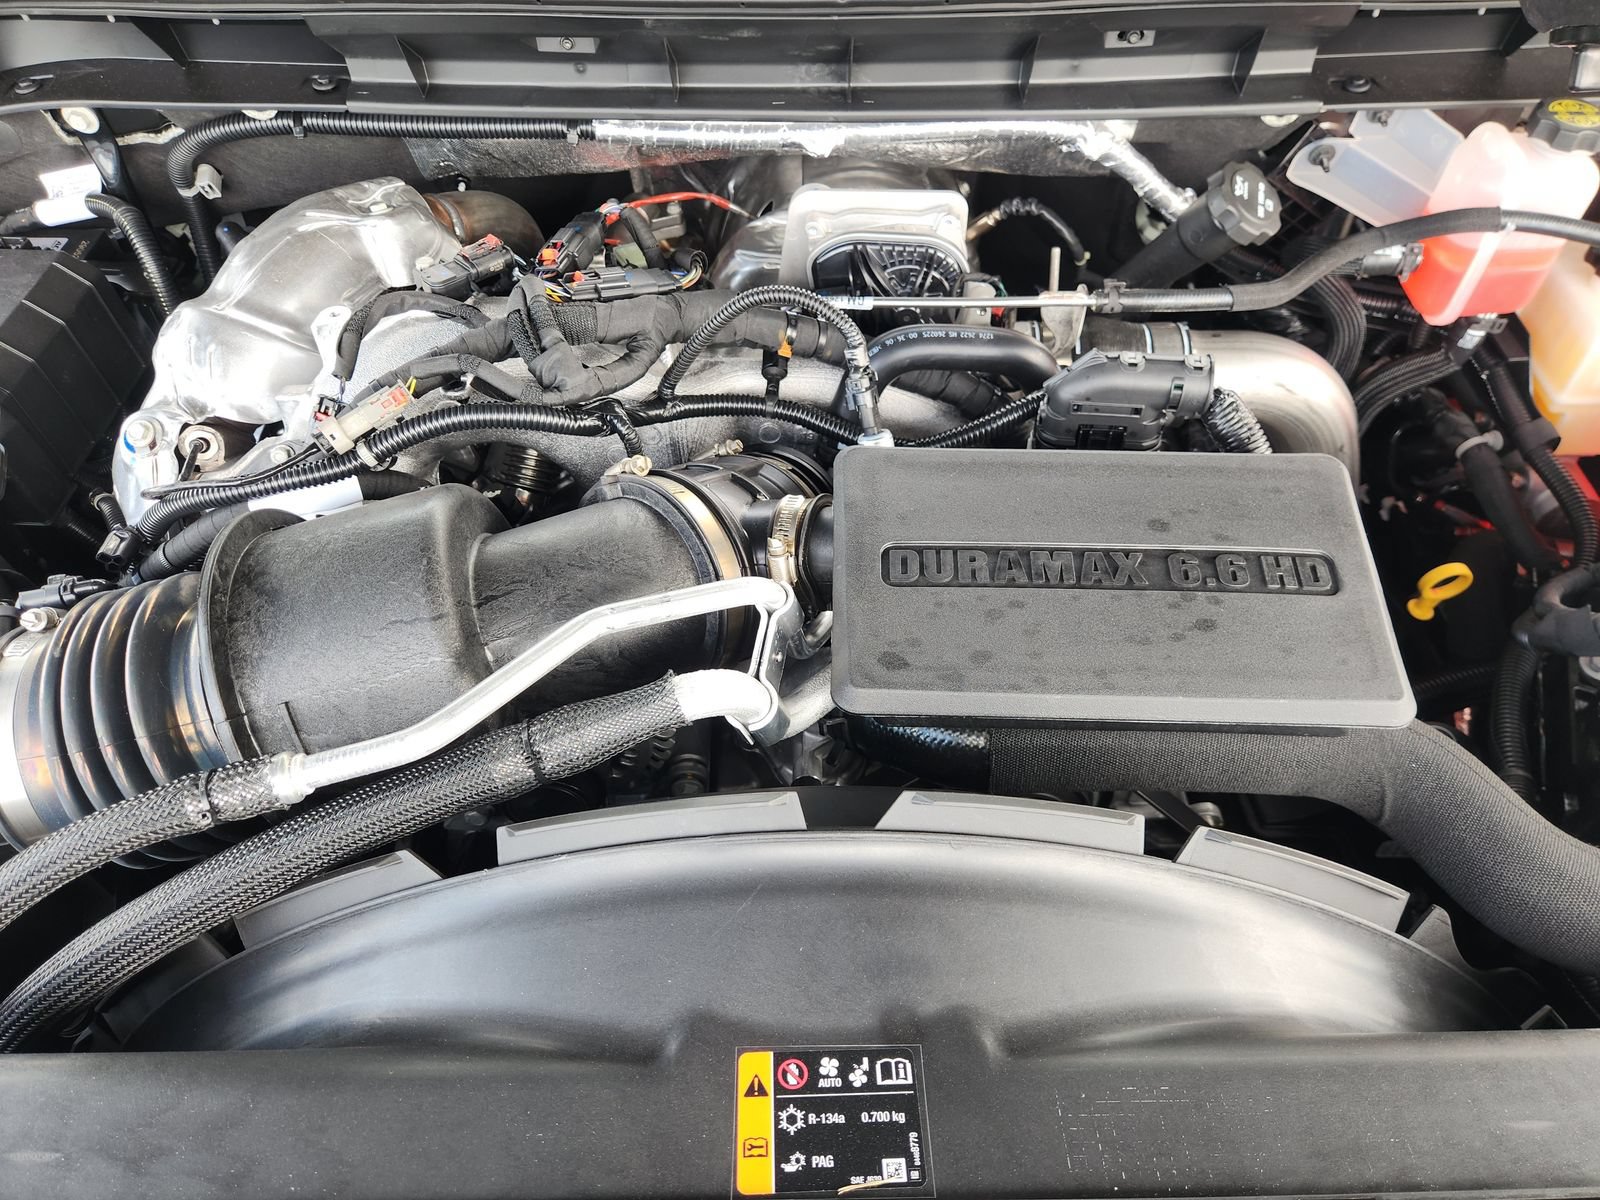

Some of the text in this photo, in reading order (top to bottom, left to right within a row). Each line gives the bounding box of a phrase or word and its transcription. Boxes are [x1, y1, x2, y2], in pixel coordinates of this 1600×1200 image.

[888, 549, 1334, 591] DURAMAX 6.6 HD
[818, 1078, 842, 1088] AUTO
[808, 1111, 906, 1124] R-134a 0.700 kg
[812, 1155, 834, 1167] PAG
[850, 1176, 865, 1184] SAE
